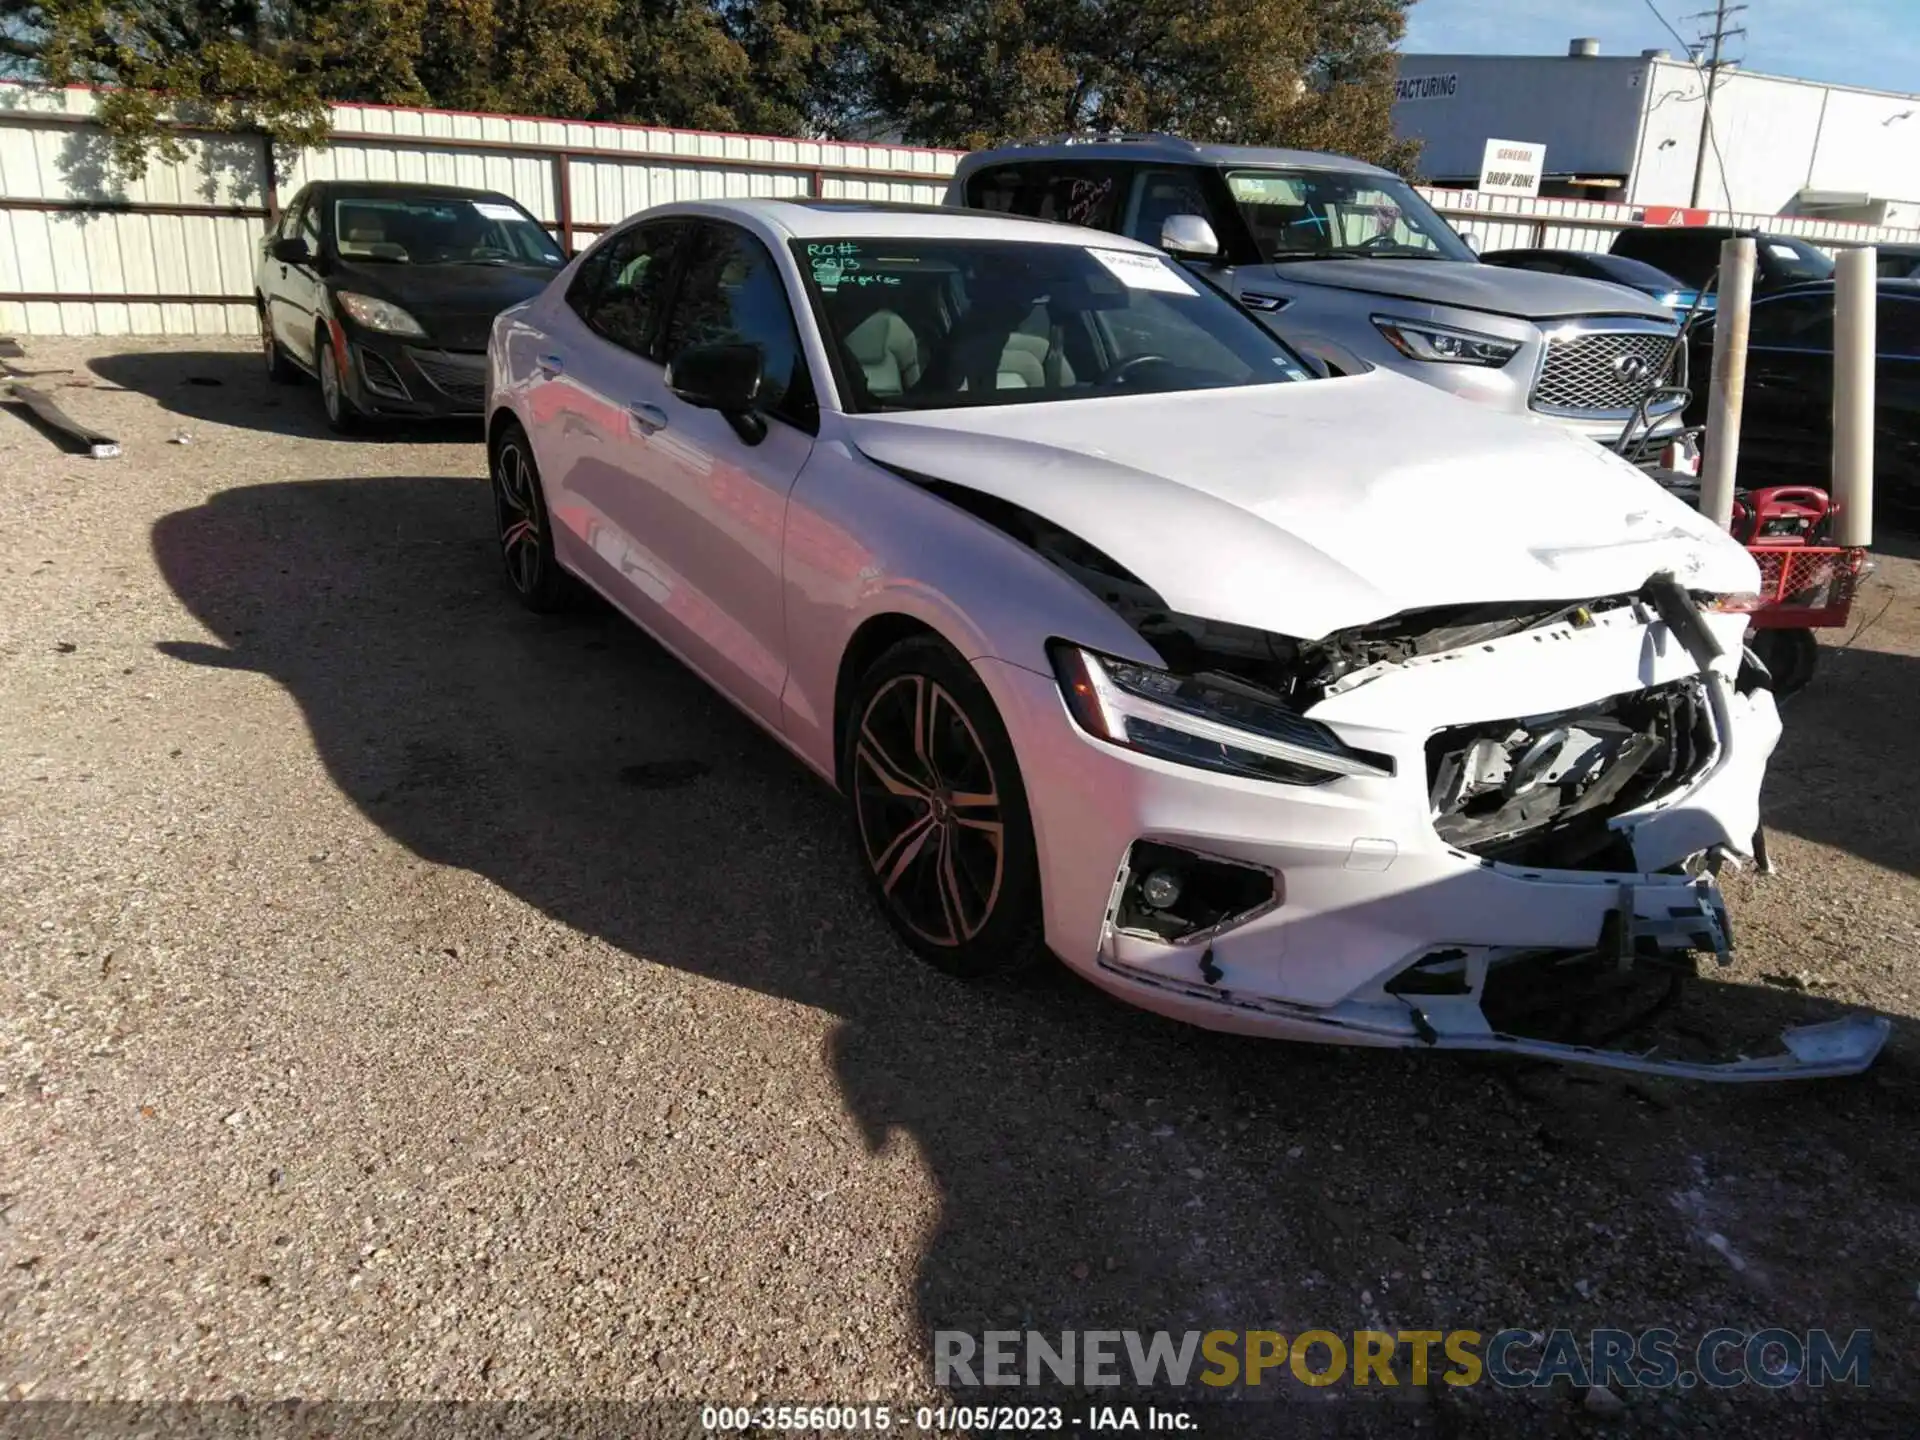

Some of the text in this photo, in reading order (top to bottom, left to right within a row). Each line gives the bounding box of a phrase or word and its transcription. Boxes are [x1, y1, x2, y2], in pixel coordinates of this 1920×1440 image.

[1497, 148, 1532, 162] GENERAL
[1486, 171, 1534, 188] DROP ZONE
